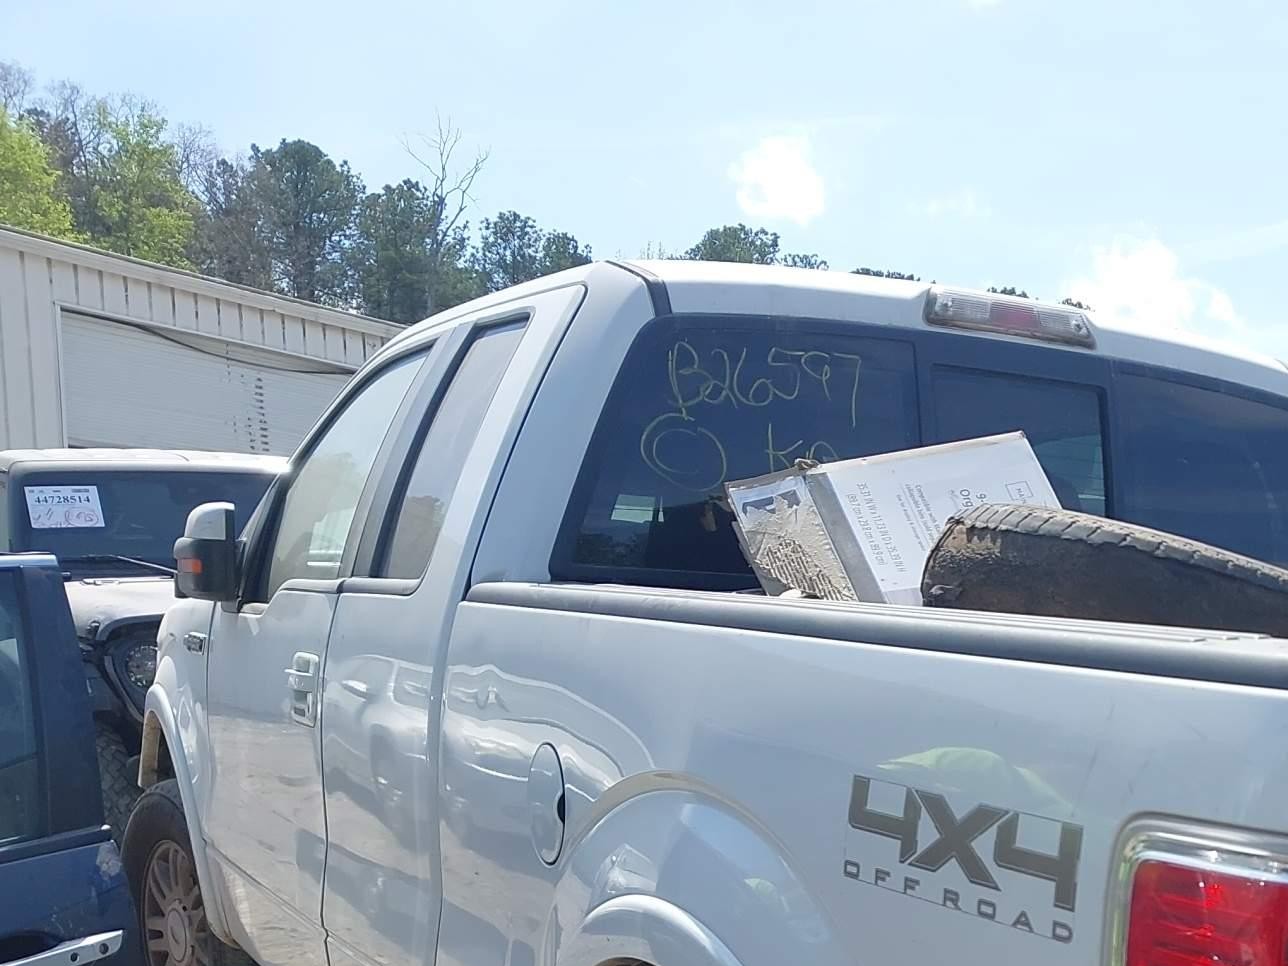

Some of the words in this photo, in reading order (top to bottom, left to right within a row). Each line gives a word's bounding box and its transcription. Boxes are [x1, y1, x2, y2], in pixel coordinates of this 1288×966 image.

[667, 339, 862, 428] B26597
[35, 495, 91, 504] 44728514
[960, 488, 974, 508] Org
[848, 774, 1084, 912] 4X4
